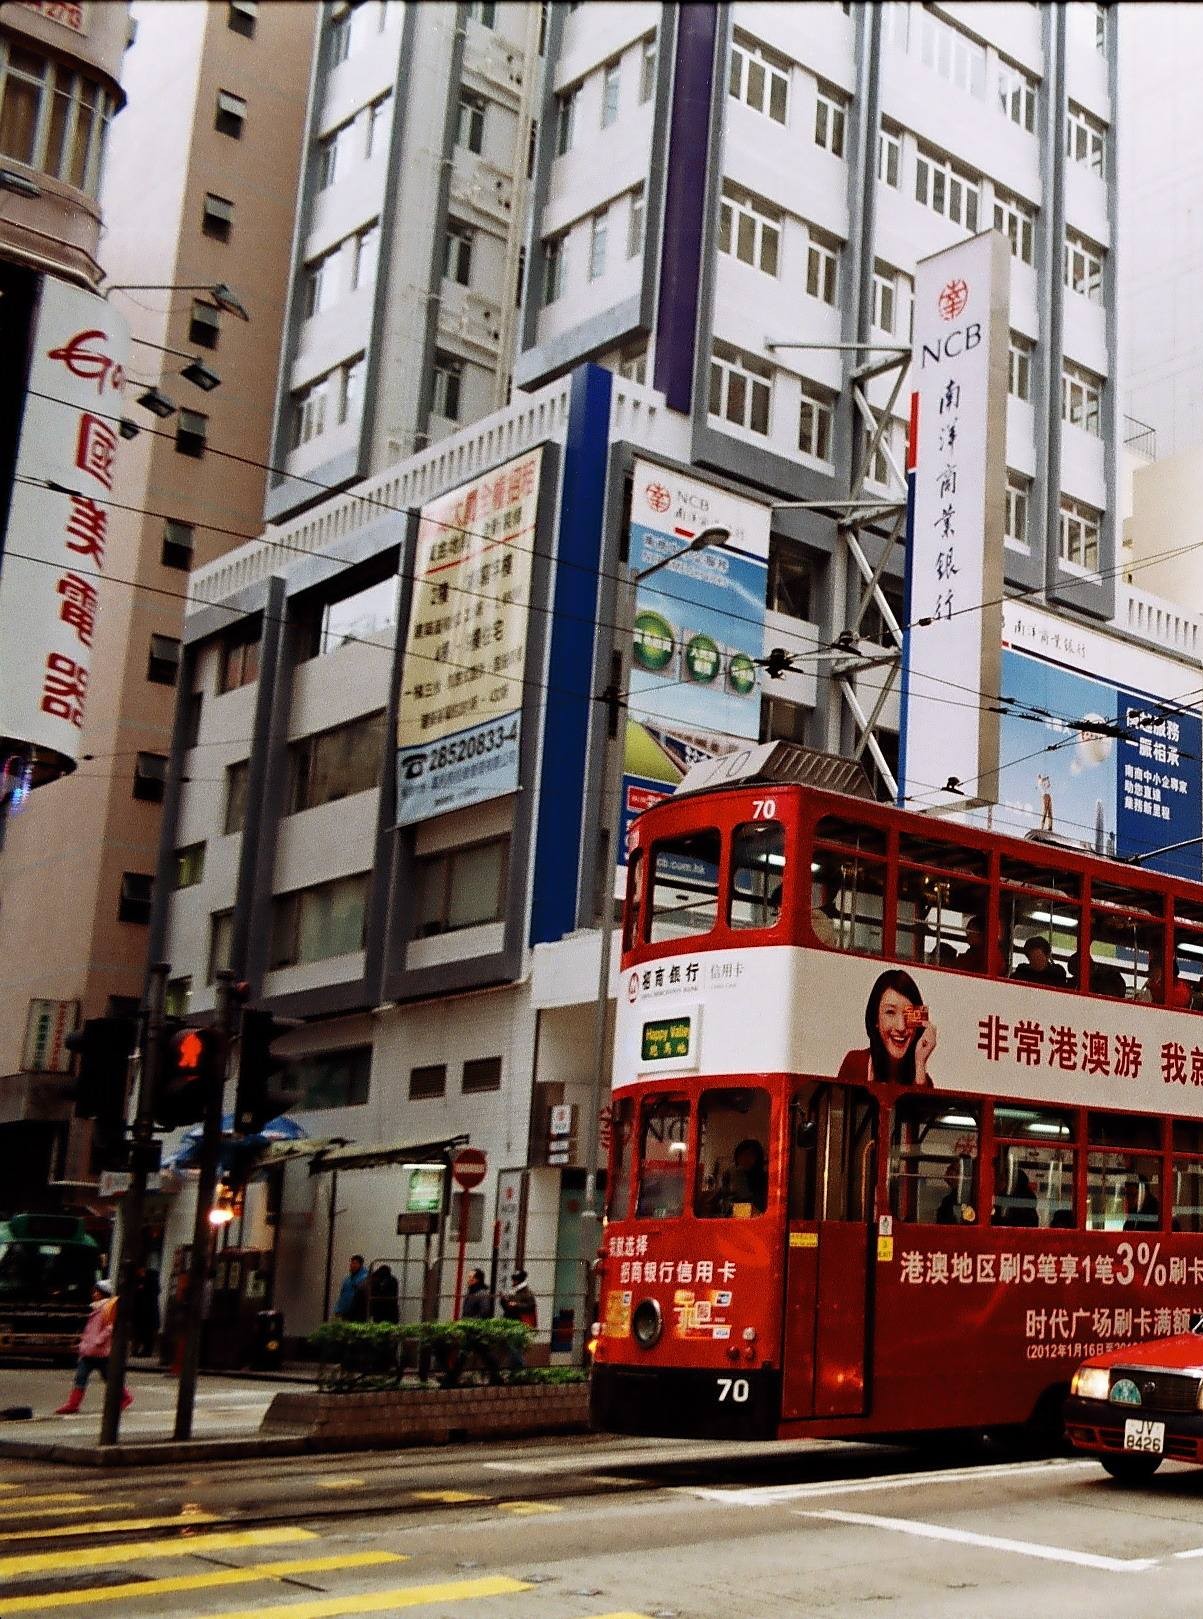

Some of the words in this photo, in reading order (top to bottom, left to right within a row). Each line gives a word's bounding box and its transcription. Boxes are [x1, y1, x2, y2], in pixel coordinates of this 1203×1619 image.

[922, 323, 982, 369] NCB
[934, 379, 961, 621] 南洋商業銀行
[752, 799, 777, 820] 70
[977, 1015, 1143, 1079] 非常港澳游
[717, 1378, 750, 1403] 70
[1136, 1420, 1156, 1435] JV
[1127, 1434, 1162, 1453] 8426
